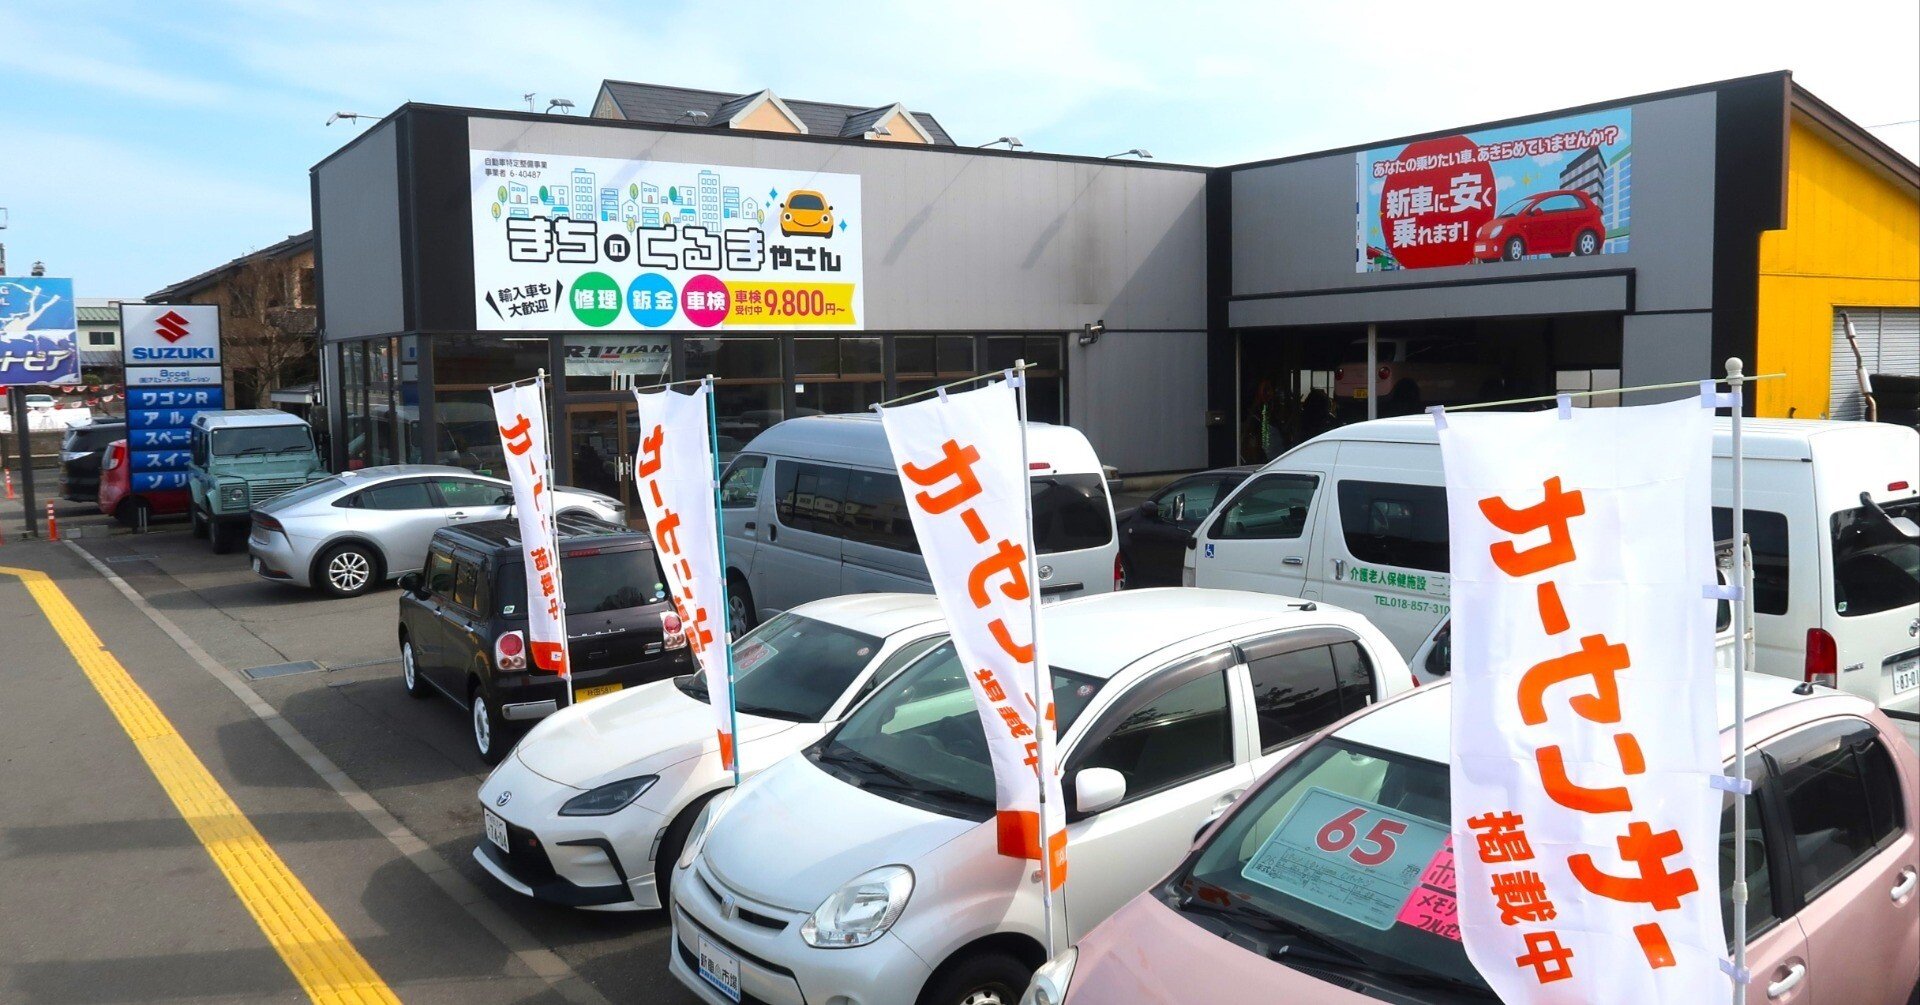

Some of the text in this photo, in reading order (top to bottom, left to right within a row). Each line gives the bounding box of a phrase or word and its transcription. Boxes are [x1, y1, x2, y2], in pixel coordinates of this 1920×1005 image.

[485, 168, 506, 177] 事業者
[1386, 172, 1493, 219] 新車に安く
[506, 215, 842, 272] まちのくるまやさん
[498, 283, 551, 303] 輸入車も
[574, 287, 618, 311] 修理
[632, 289, 676, 311] 鈑金
[686, 290, 726, 311] 車検
[735, 290, 761, 304] 車検
[508, 298, 549, 318] 大歓迎
[735, 305, 763, 316] 受付中
[132, 347, 214, 360] SUZUKI
[142, 391, 208, 406] ワゴンR
[1350, 566, 1427, 592] 介護老人保健施設
[1478, 475, 1700, 969] カーセンサー
[1315, 806, 1410, 867] 65
[1467, 811, 1575, 986] 掲載中
